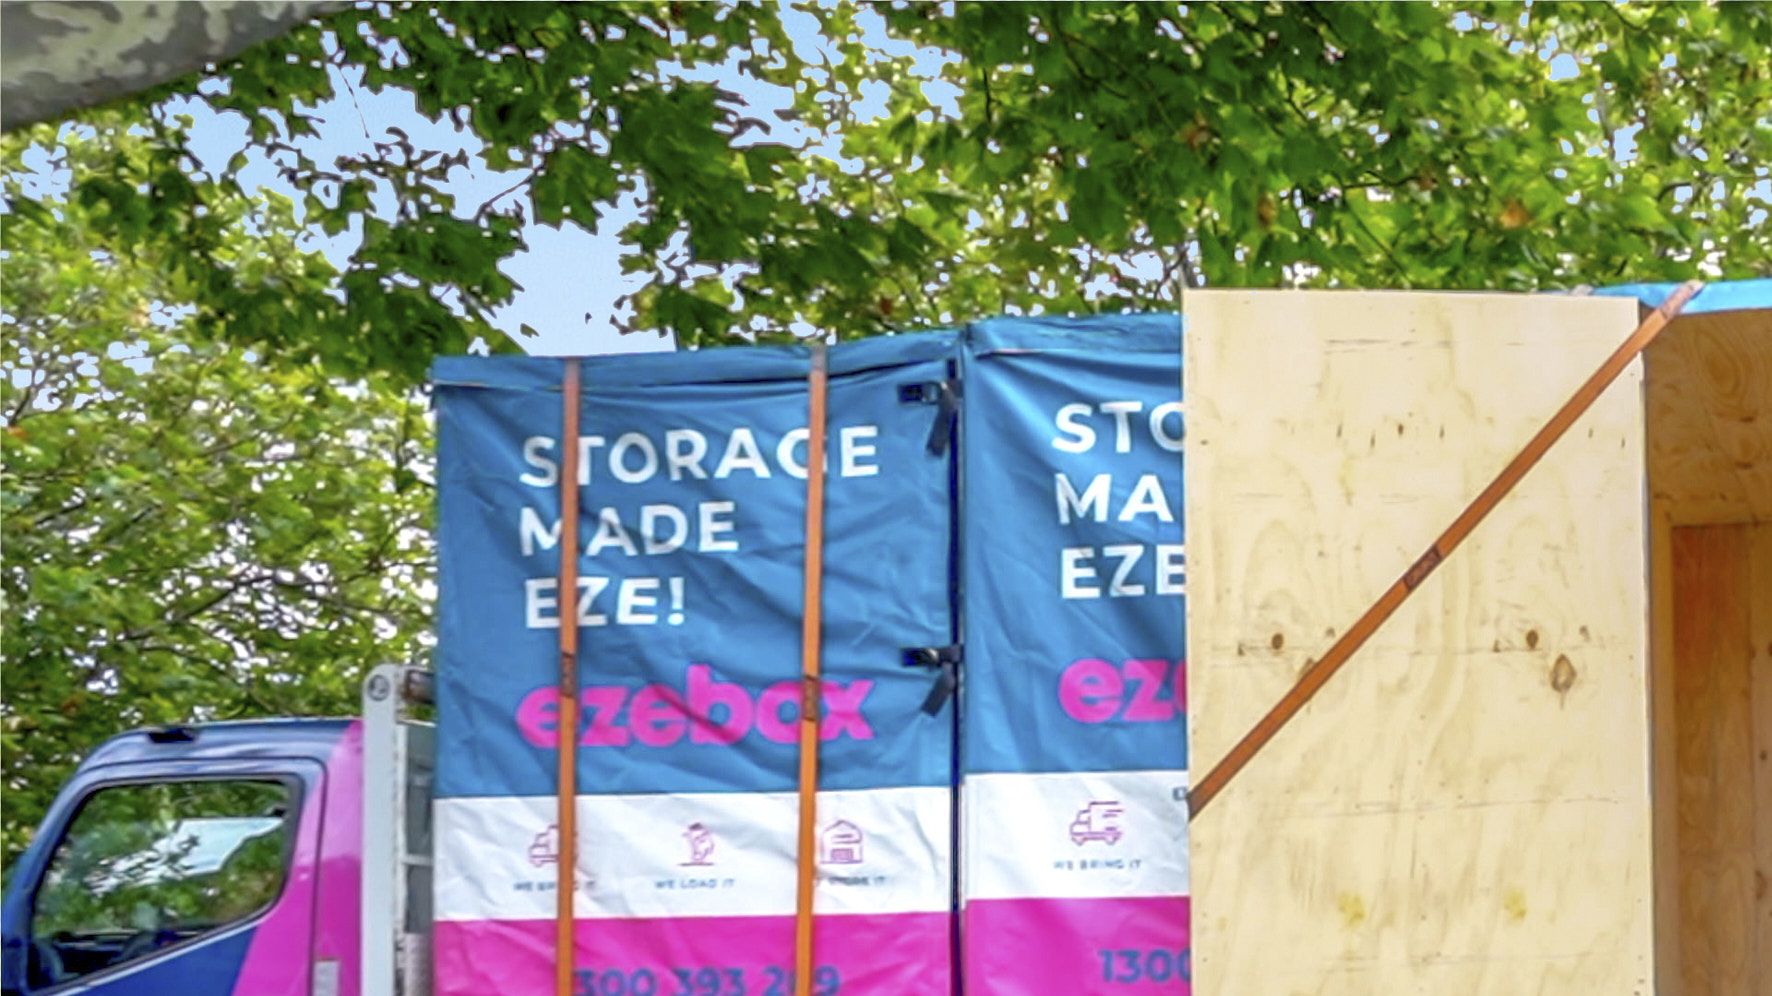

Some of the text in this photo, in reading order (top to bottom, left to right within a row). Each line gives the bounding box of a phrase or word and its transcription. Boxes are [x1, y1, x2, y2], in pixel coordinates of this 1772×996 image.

[519, 425, 879, 487] STORAGE
[519, 500, 739, 556] MADE
[525, 577, 685, 629] EZE!
[515, 664, 875, 748] ezebox
[1058, 657, 1187, 723] ez
